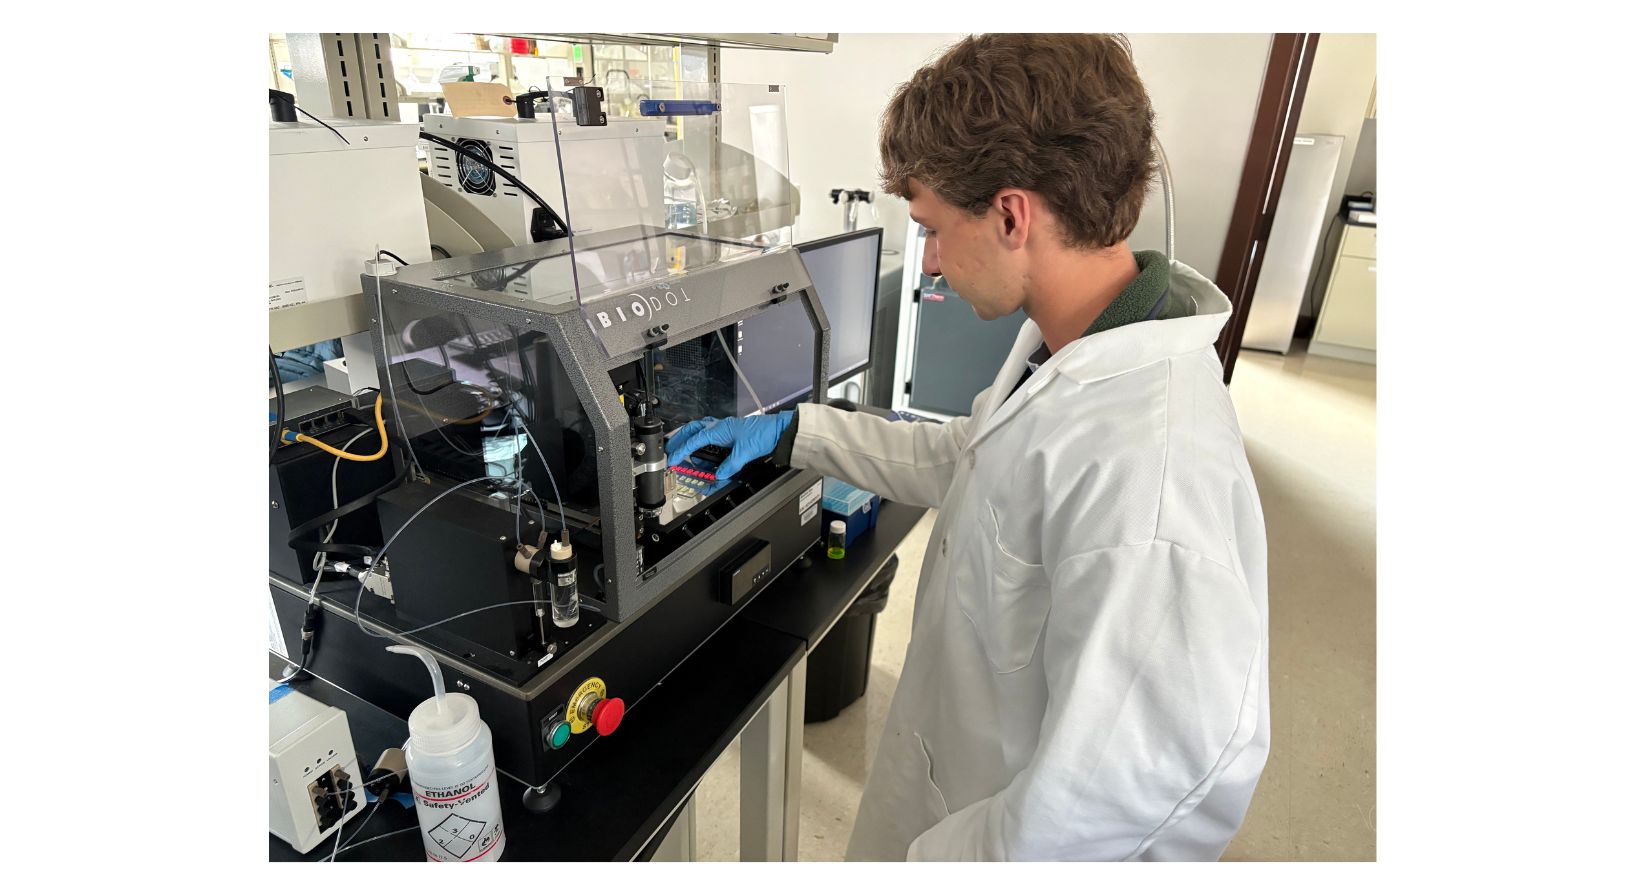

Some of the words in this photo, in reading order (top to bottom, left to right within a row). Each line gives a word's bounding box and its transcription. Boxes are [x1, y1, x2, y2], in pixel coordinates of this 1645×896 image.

[570, 682, 602, 714] EMERGENCY
[423, 782, 490, 809] Safety-Vented
[425, 783, 476, 798] ETHANOL
